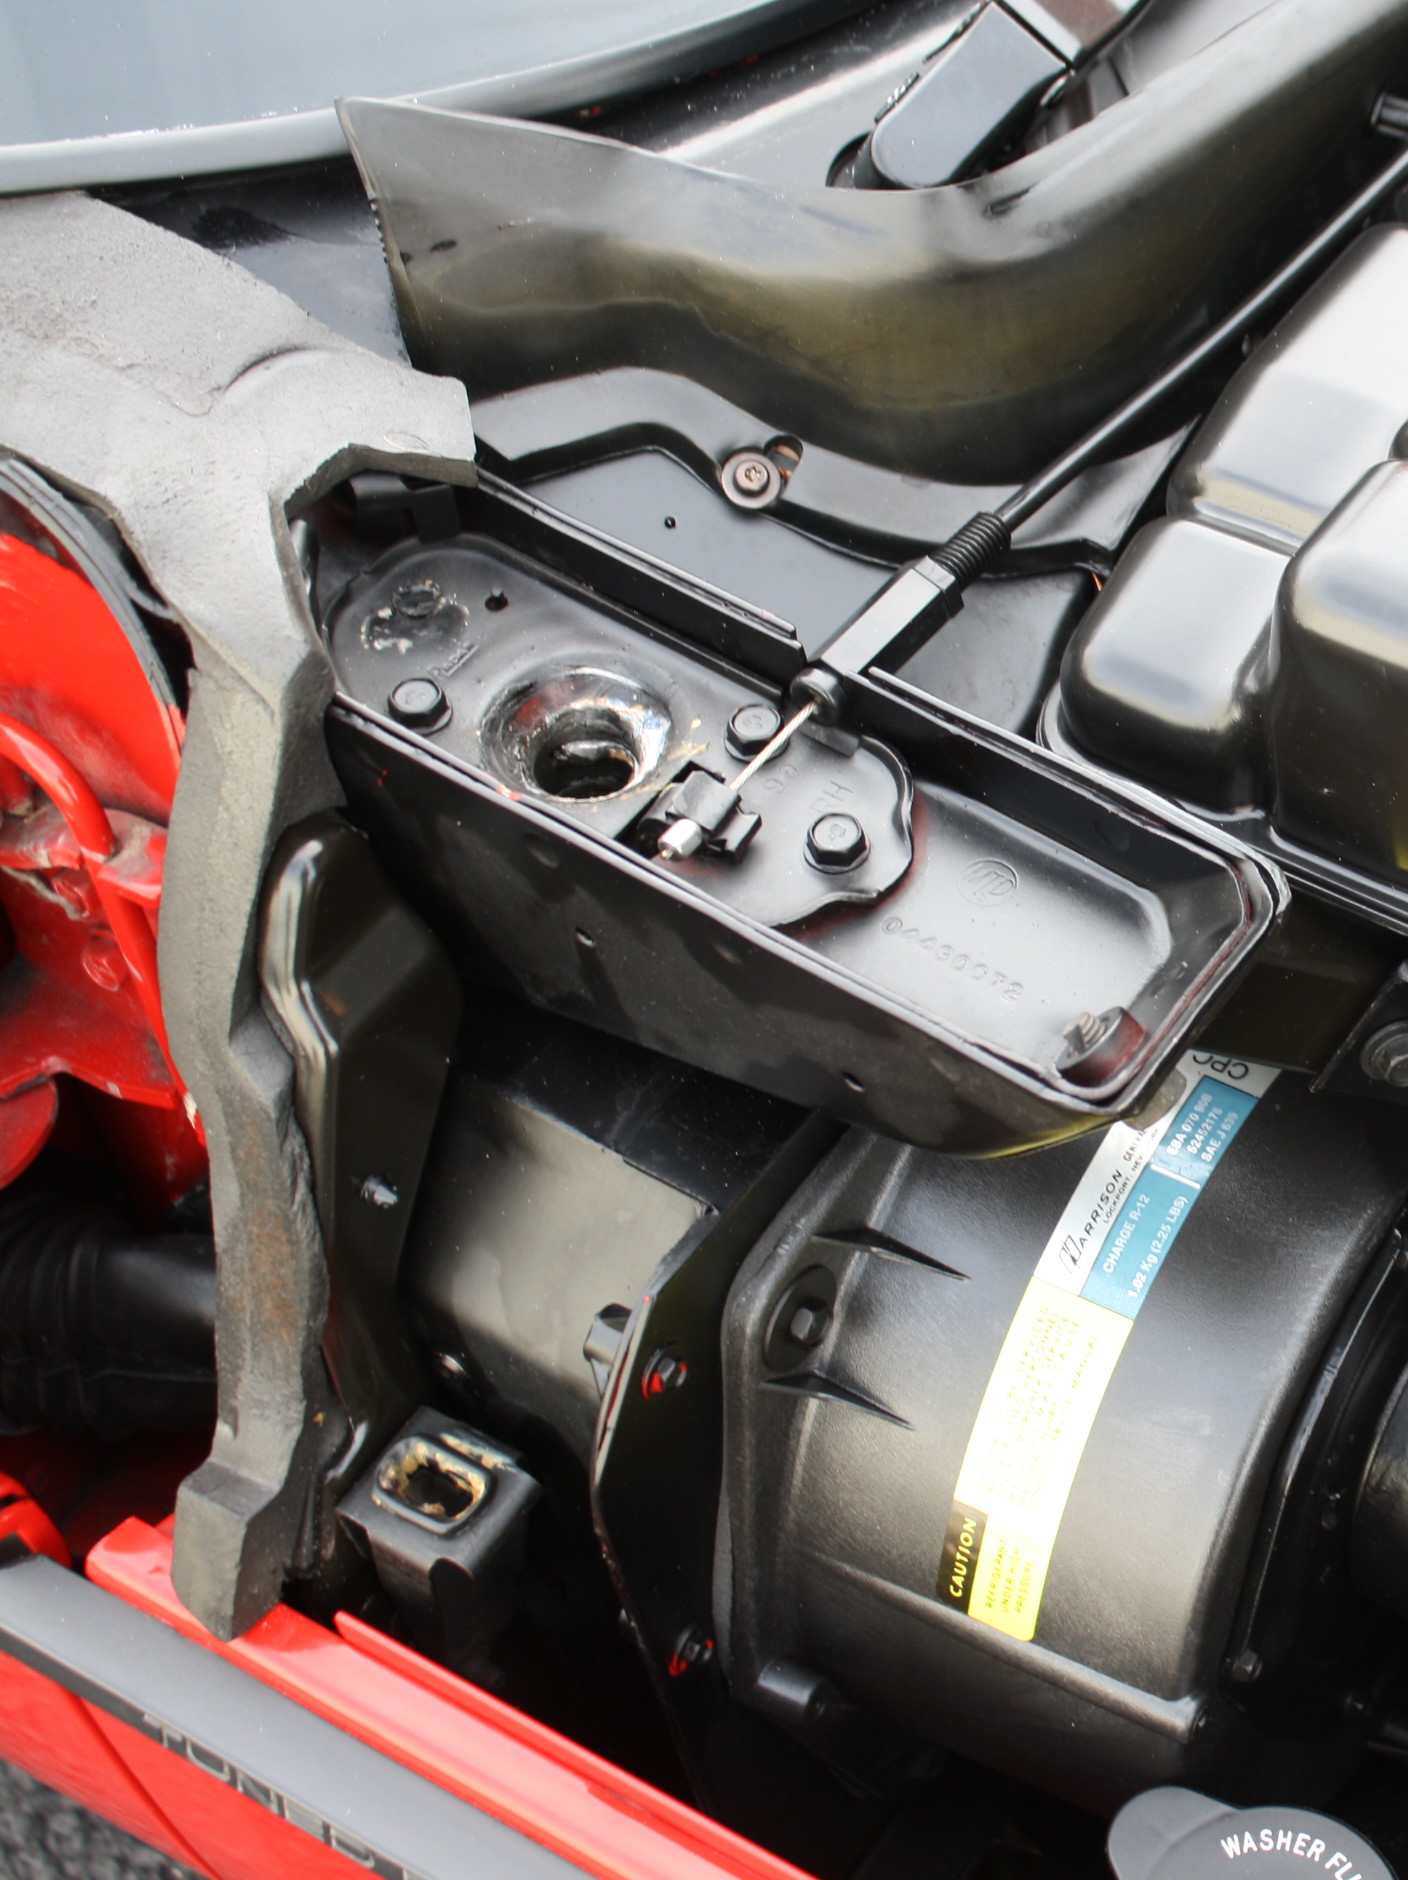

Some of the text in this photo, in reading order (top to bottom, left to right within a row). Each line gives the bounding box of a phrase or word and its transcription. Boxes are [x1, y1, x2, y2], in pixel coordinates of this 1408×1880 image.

[1165, 1131, 1187, 1156] EBA
[1180, 1111, 1200, 1133] 070
[1200, 1136, 1222, 1162] SAE
[1101, 1192, 1151, 1273] CHARGE R-12
[1126, 1194, 1189, 1299] 1.02 Kg (2.25 LBS)
[949, 1517, 978, 1597] CAUTION
[983, 1535, 1008, 1609] REFRIGERANT
[998, 1576, 1015, 1614] UNDER
[1012, 1559, 1035, 1615] PRESSURE
[1220, 1828, 1362, 1880] WASHER FL
